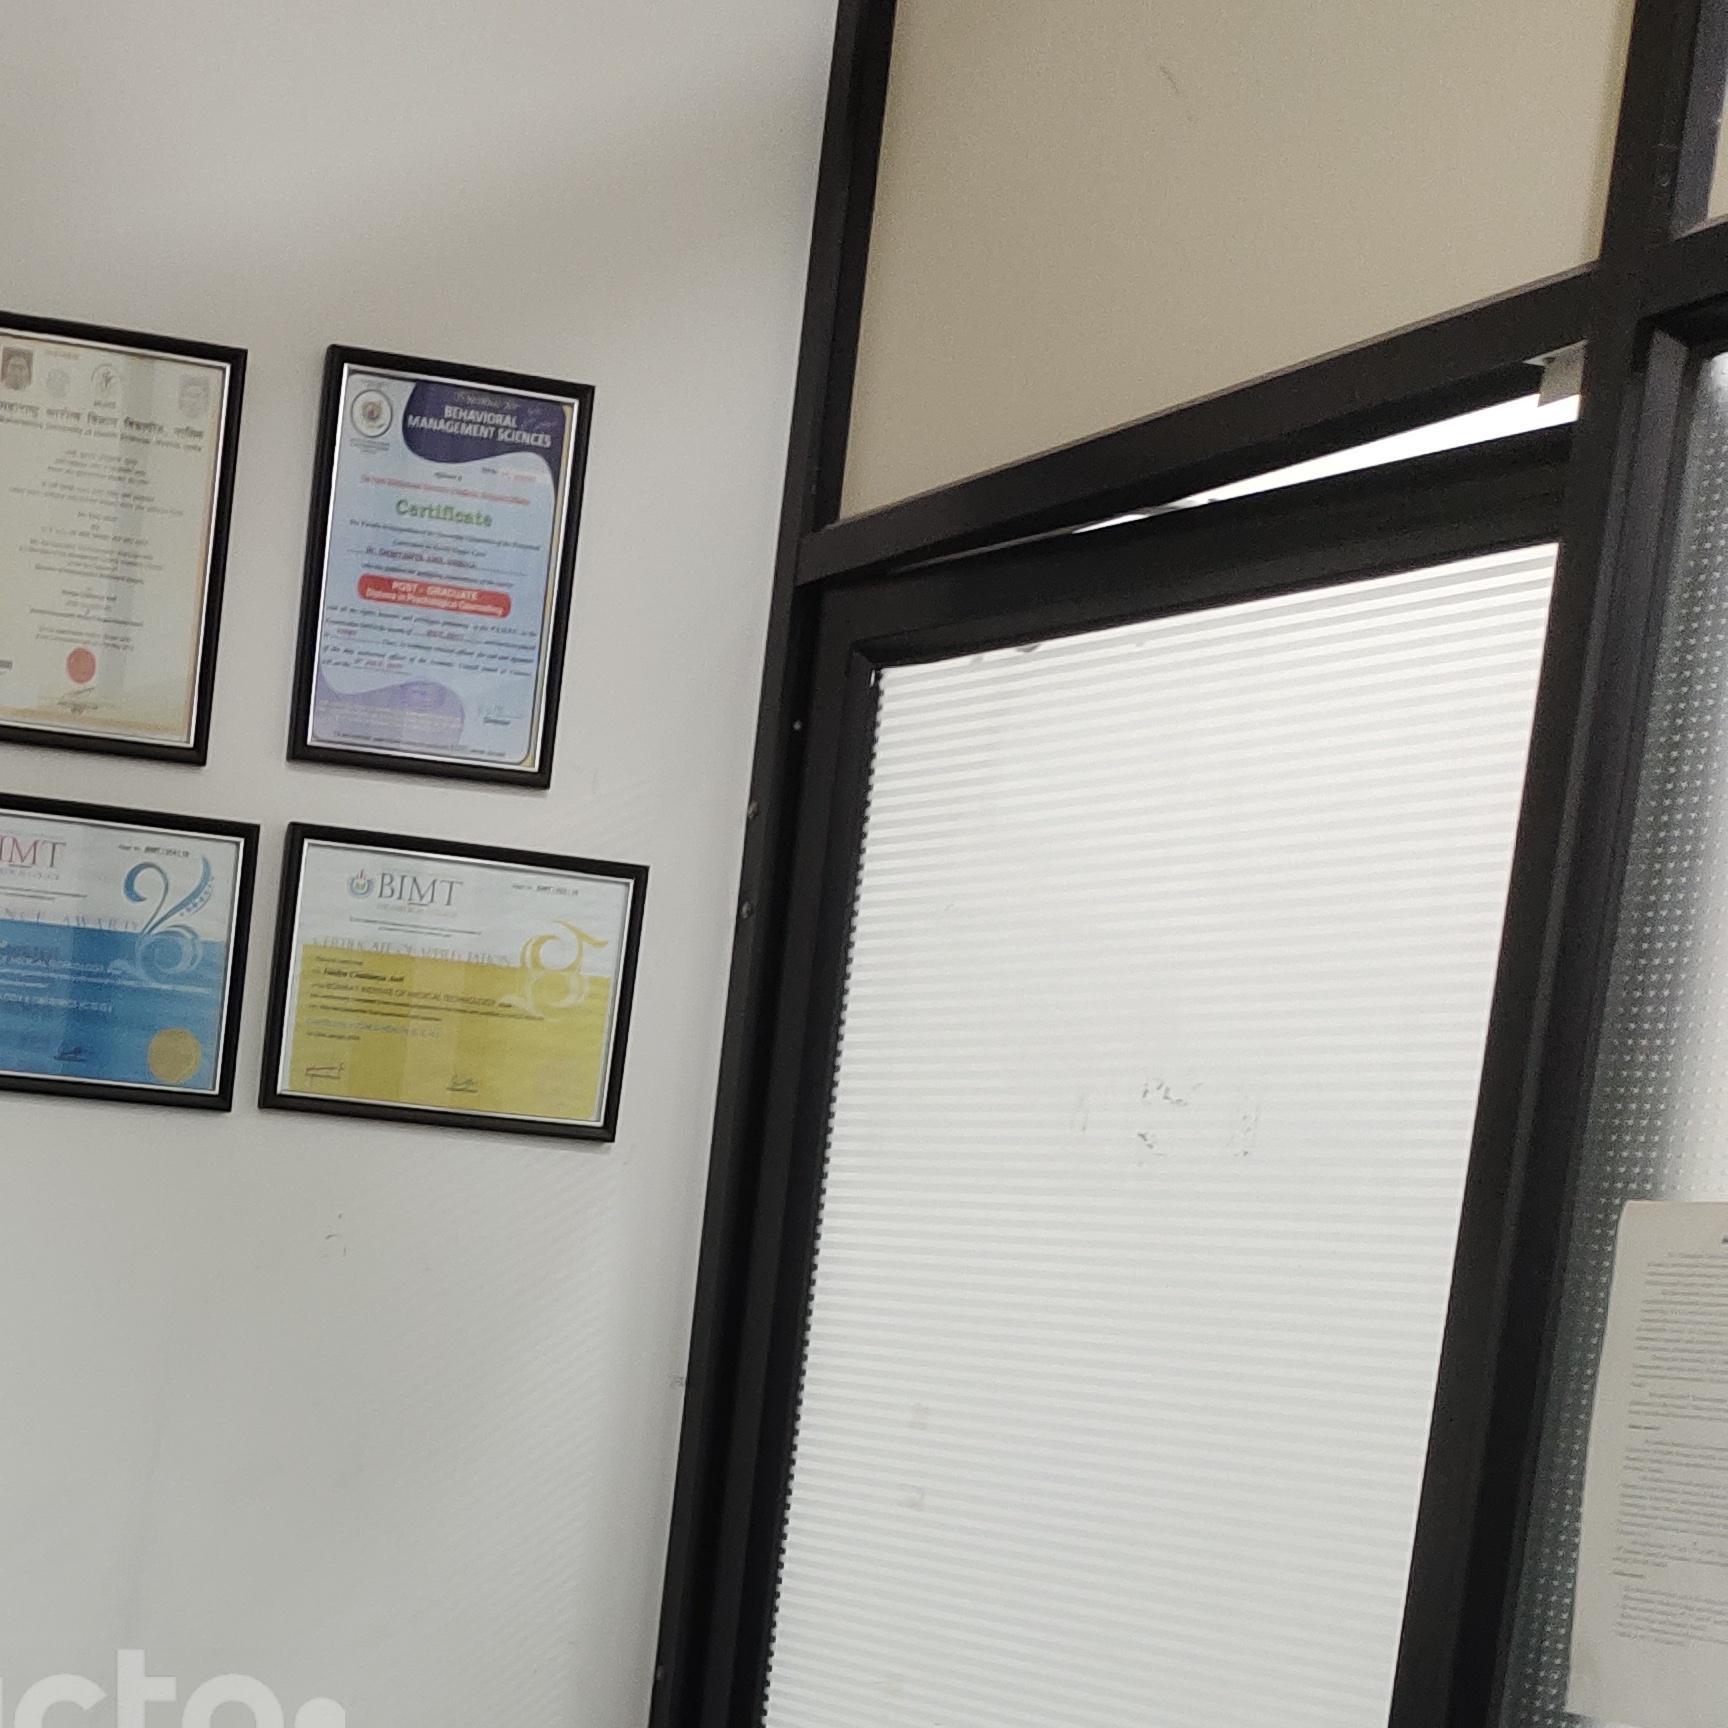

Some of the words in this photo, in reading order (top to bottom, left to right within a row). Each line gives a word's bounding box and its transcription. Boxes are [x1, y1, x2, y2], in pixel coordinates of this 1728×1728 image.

[443, 404, 519, 428] BEHAVIORAL
[407, 413, 495, 440] MANAGEMENT
[497, 429, 553, 449] SCIENCES
[395, 499, 494, 528] Certificate
[391, 580, 418, 593] POST
[426, 584, 479, 600] GRADUATE
[376, 871, 464, 907] BIMT
